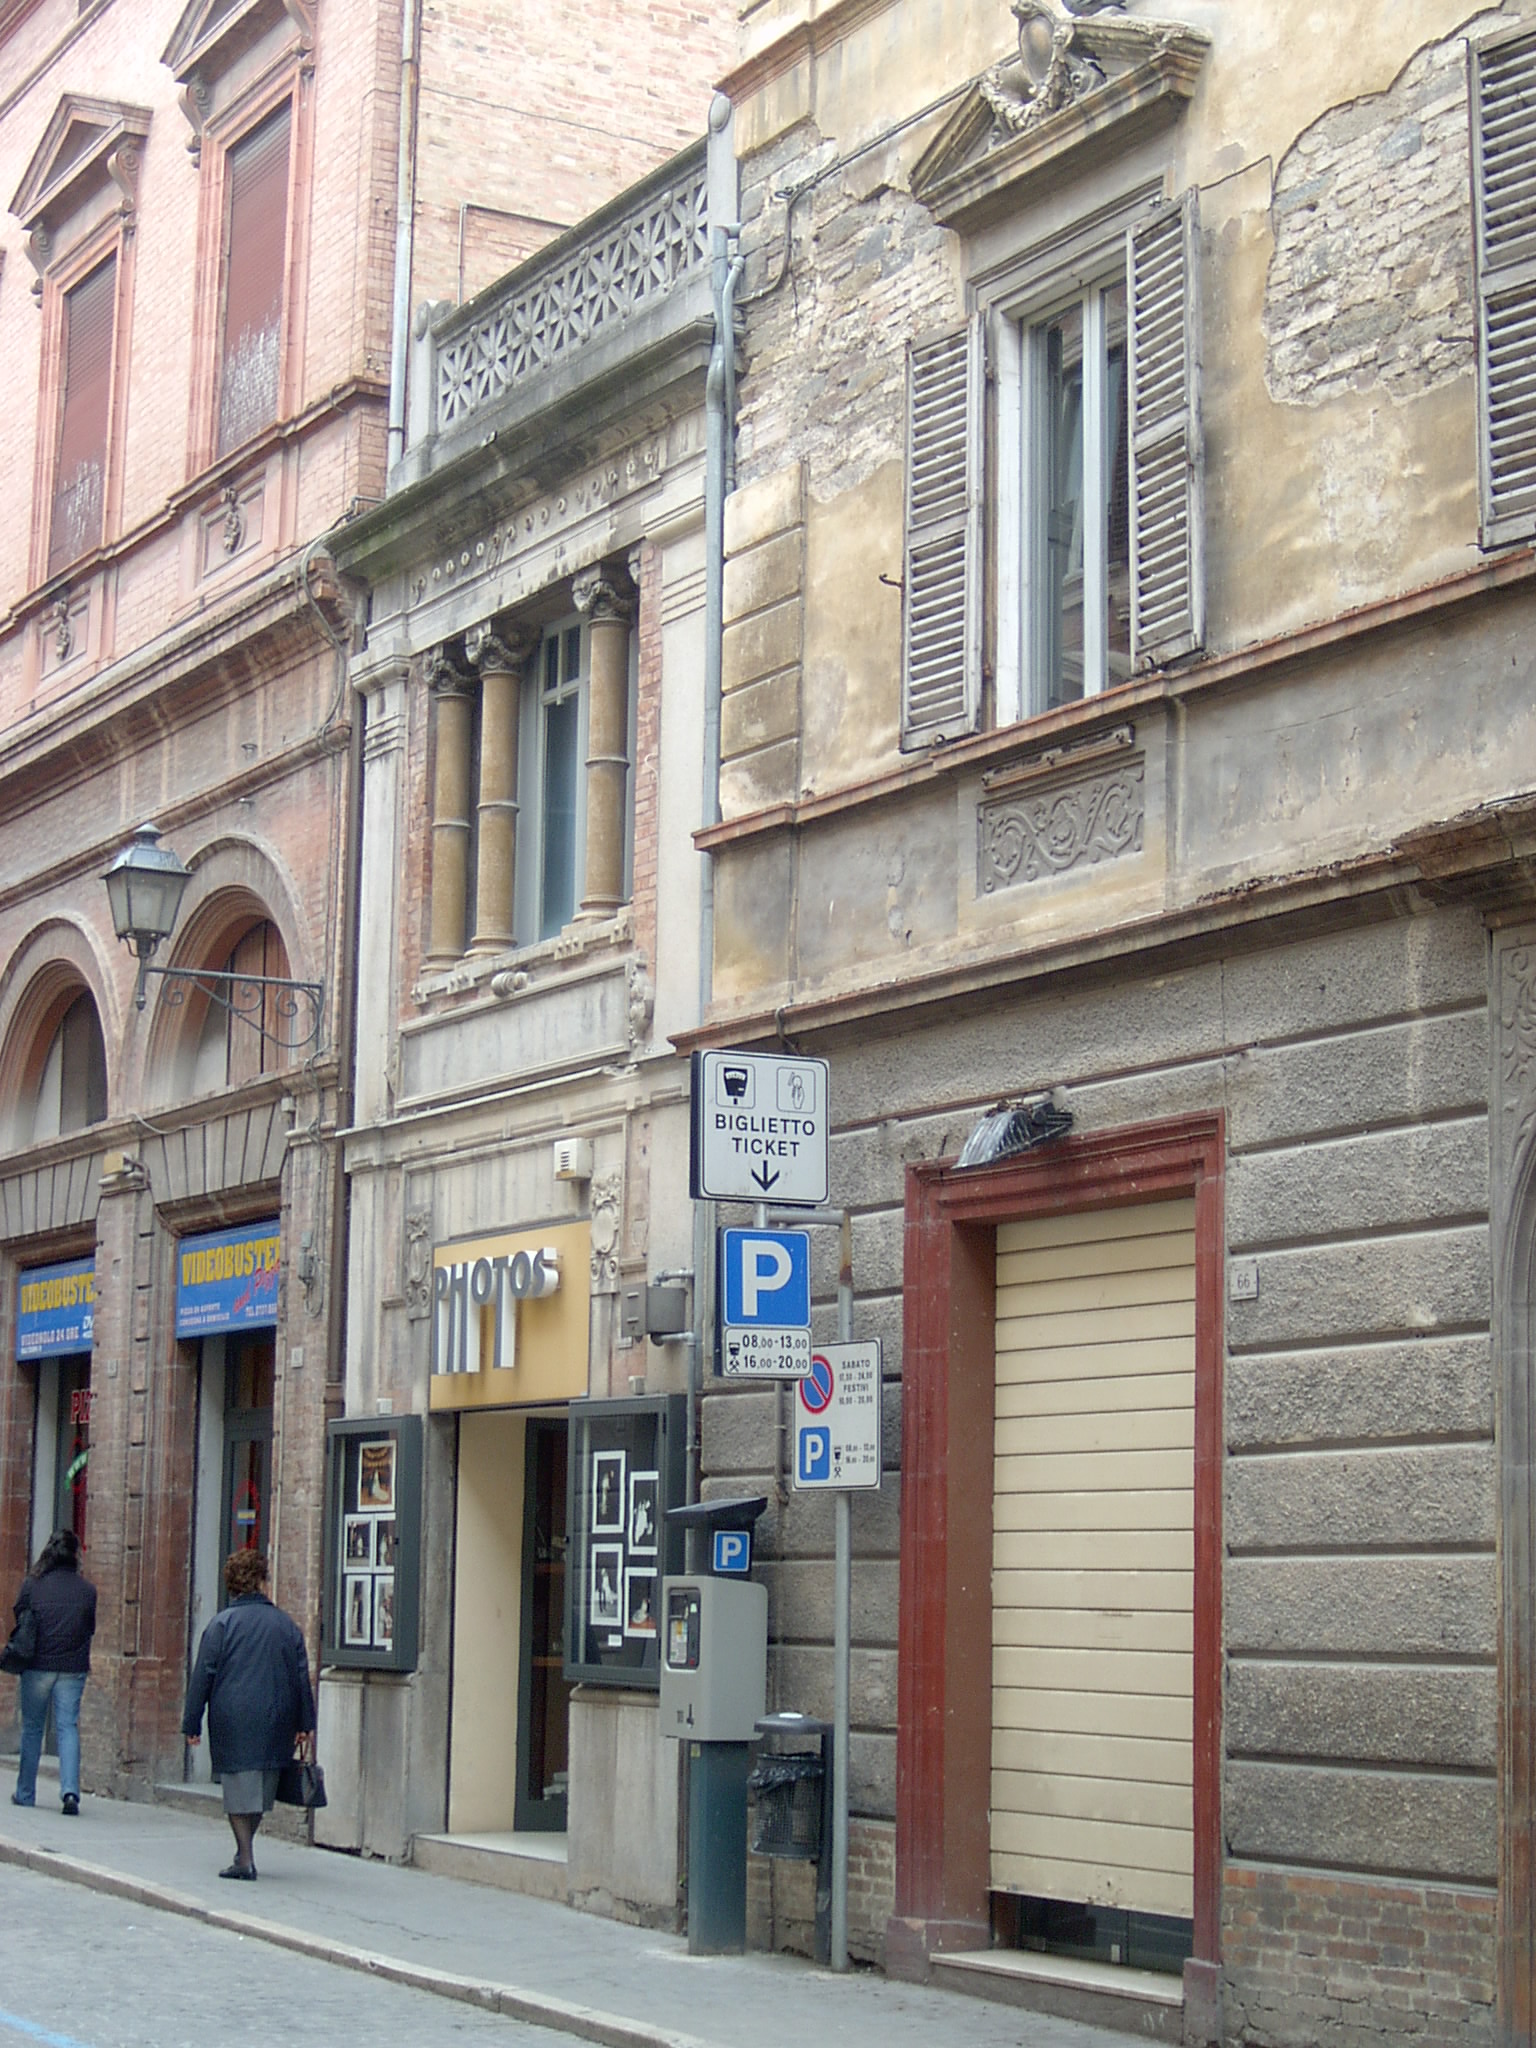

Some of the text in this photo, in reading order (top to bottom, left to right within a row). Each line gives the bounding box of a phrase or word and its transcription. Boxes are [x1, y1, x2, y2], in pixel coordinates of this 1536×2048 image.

[715, 1113, 816, 1137] BIGLIETTO
[731, 1137, 801, 1157] TICKET
[742, 1239, 793, 1317] P
[1237, 1272, 1250, 1290] 66
[432, 1247, 559, 1376] PHOTOS
[842, 1359, 871, 1369] SABATO
[843, 1383, 870, 1393] FESTIVI
[805, 1434, 824, 1475] P
[721, 1536, 742, 1567] P
